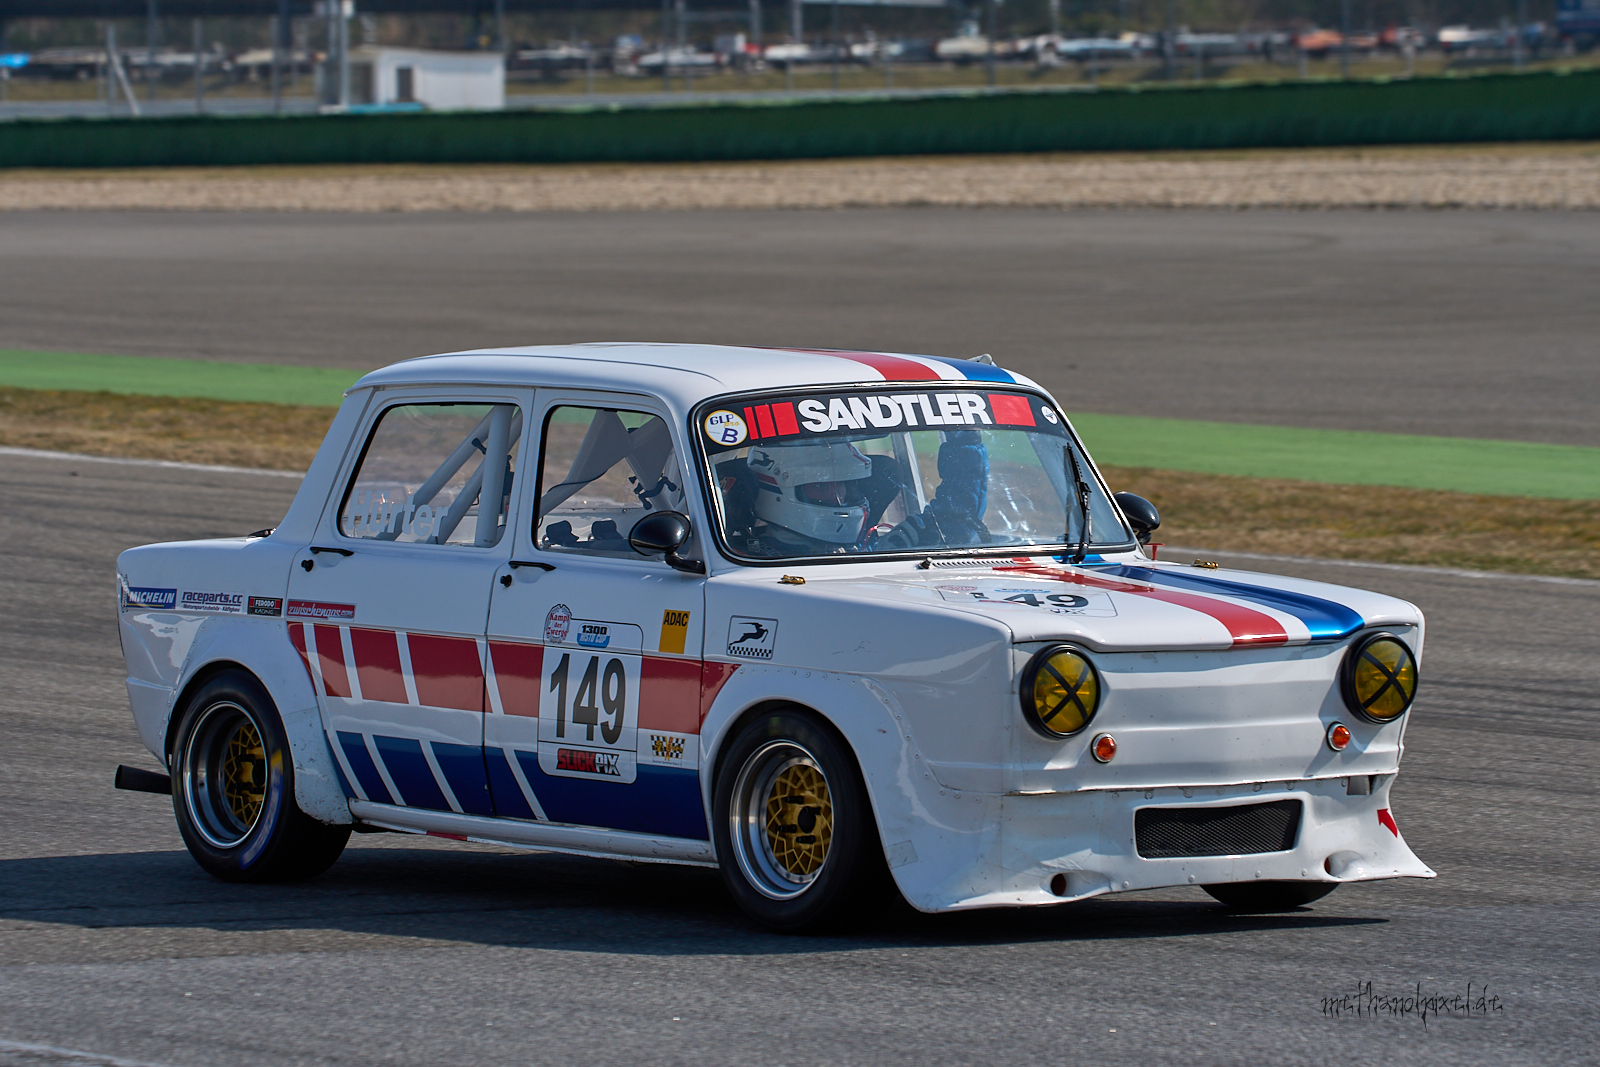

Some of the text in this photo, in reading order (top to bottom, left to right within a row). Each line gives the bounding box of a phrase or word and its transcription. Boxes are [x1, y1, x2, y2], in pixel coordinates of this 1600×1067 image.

[710, 414, 734, 425] GLP
[798, 394, 992, 432] SANDTLER
[721, 428, 738, 443] B
[345, 490, 449, 537] Hürter
[129, 591, 175, 603] MICHELIN
[182, 591, 243, 605] raceparts.cc
[255, 599, 275, 608] FERODO
[549, 612, 570, 623] Kampf
[663, 611, 688, 627] ADAC
[546, 627, 568, 638] Zwerge
[581, 625, 608, 635] 1300
[550, 653, 626, 744] 149
